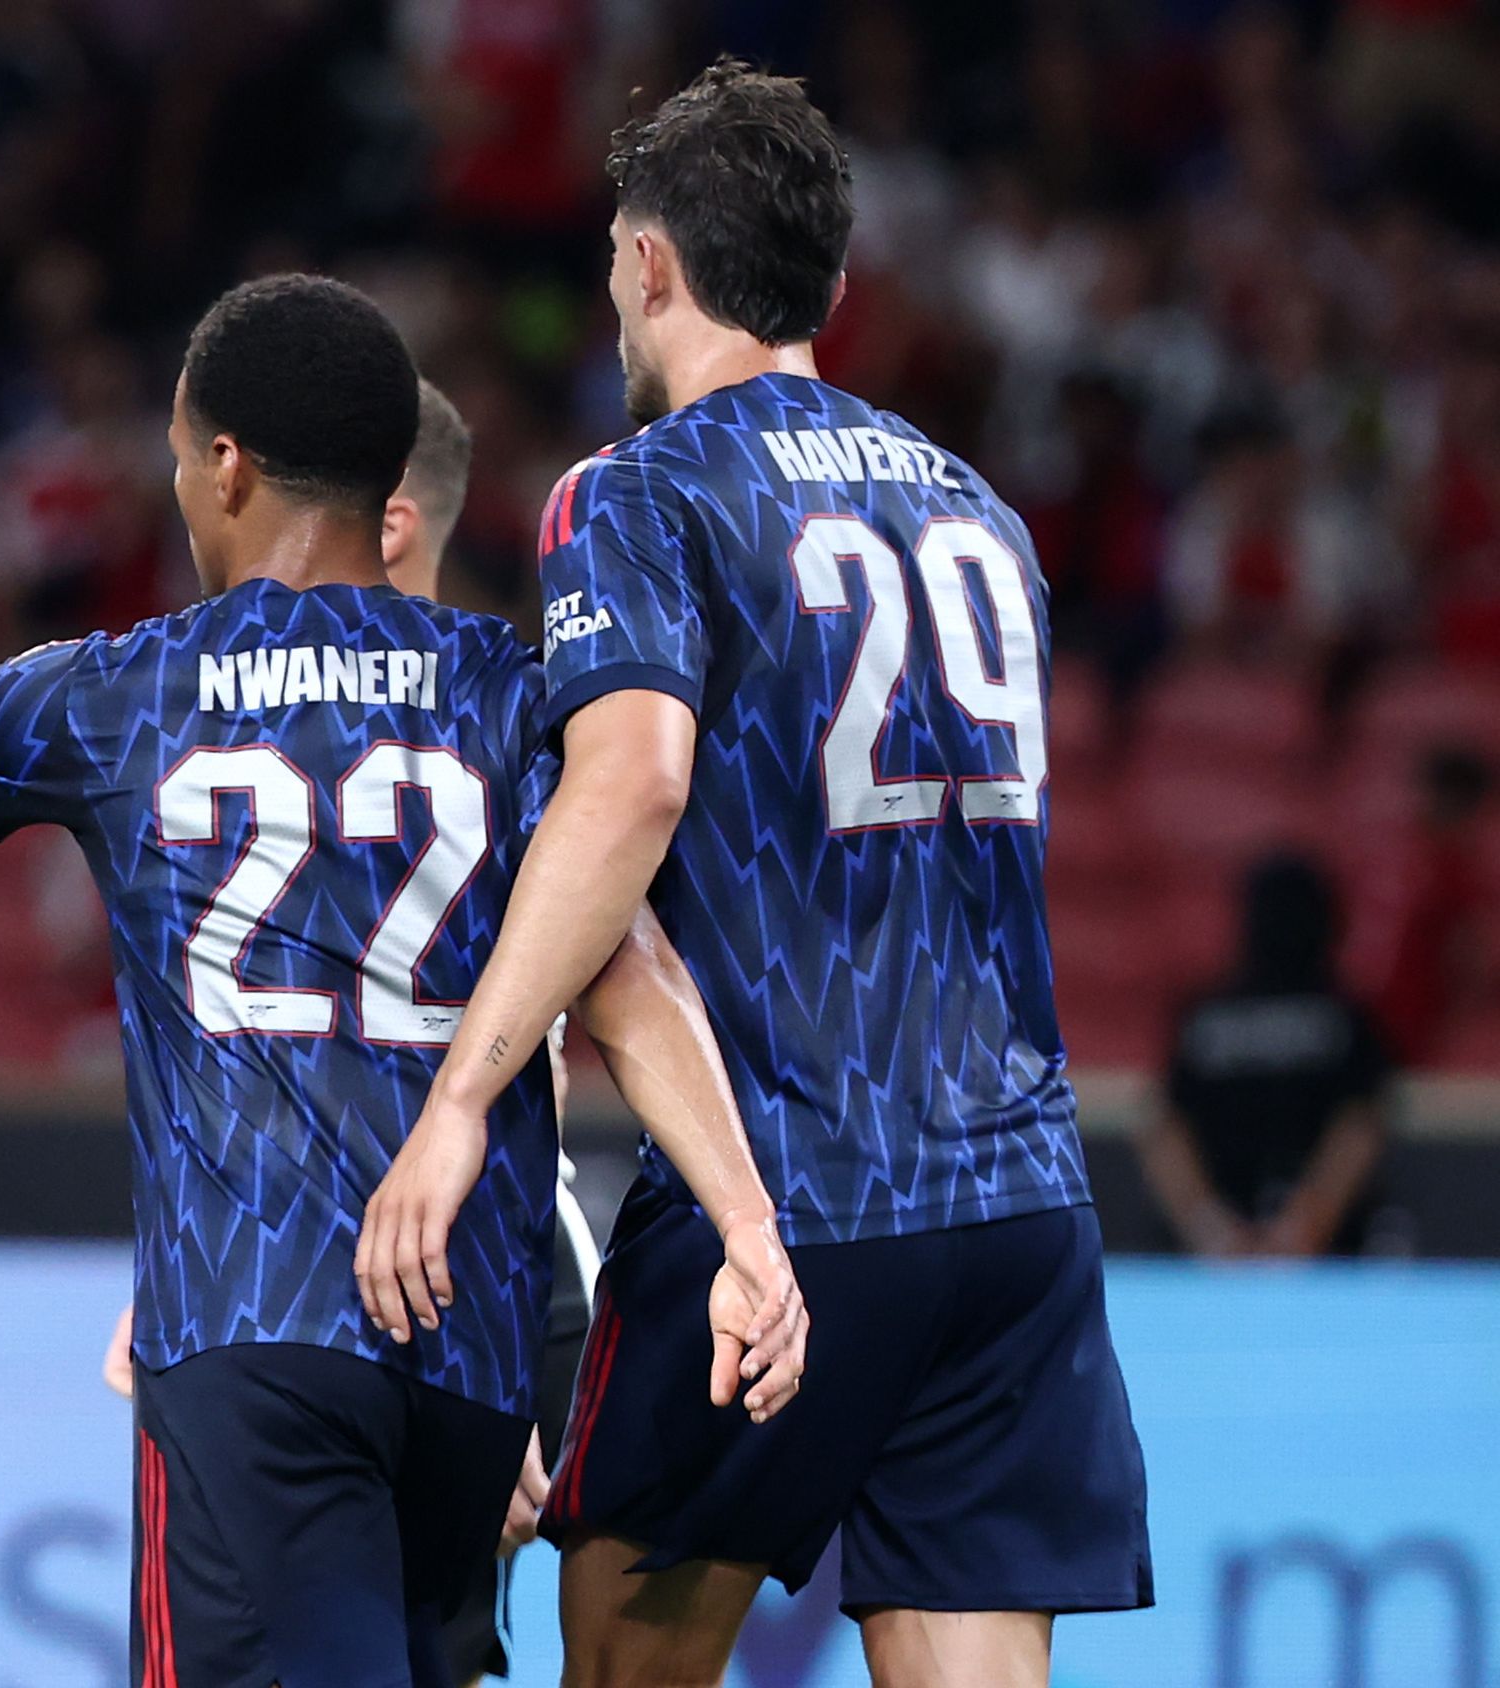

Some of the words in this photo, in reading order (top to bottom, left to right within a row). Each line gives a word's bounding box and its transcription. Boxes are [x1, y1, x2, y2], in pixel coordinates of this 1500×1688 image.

[760, 427, 962, 489] HAVERTZ
[543, 608, 613, 666] ANDA
[544, 590, 583, 630] SIT
[199, 645, 438, 711] NWANERI
[787, 512, 1049, 836] 29
[154, 738, 491, 1048] 22
